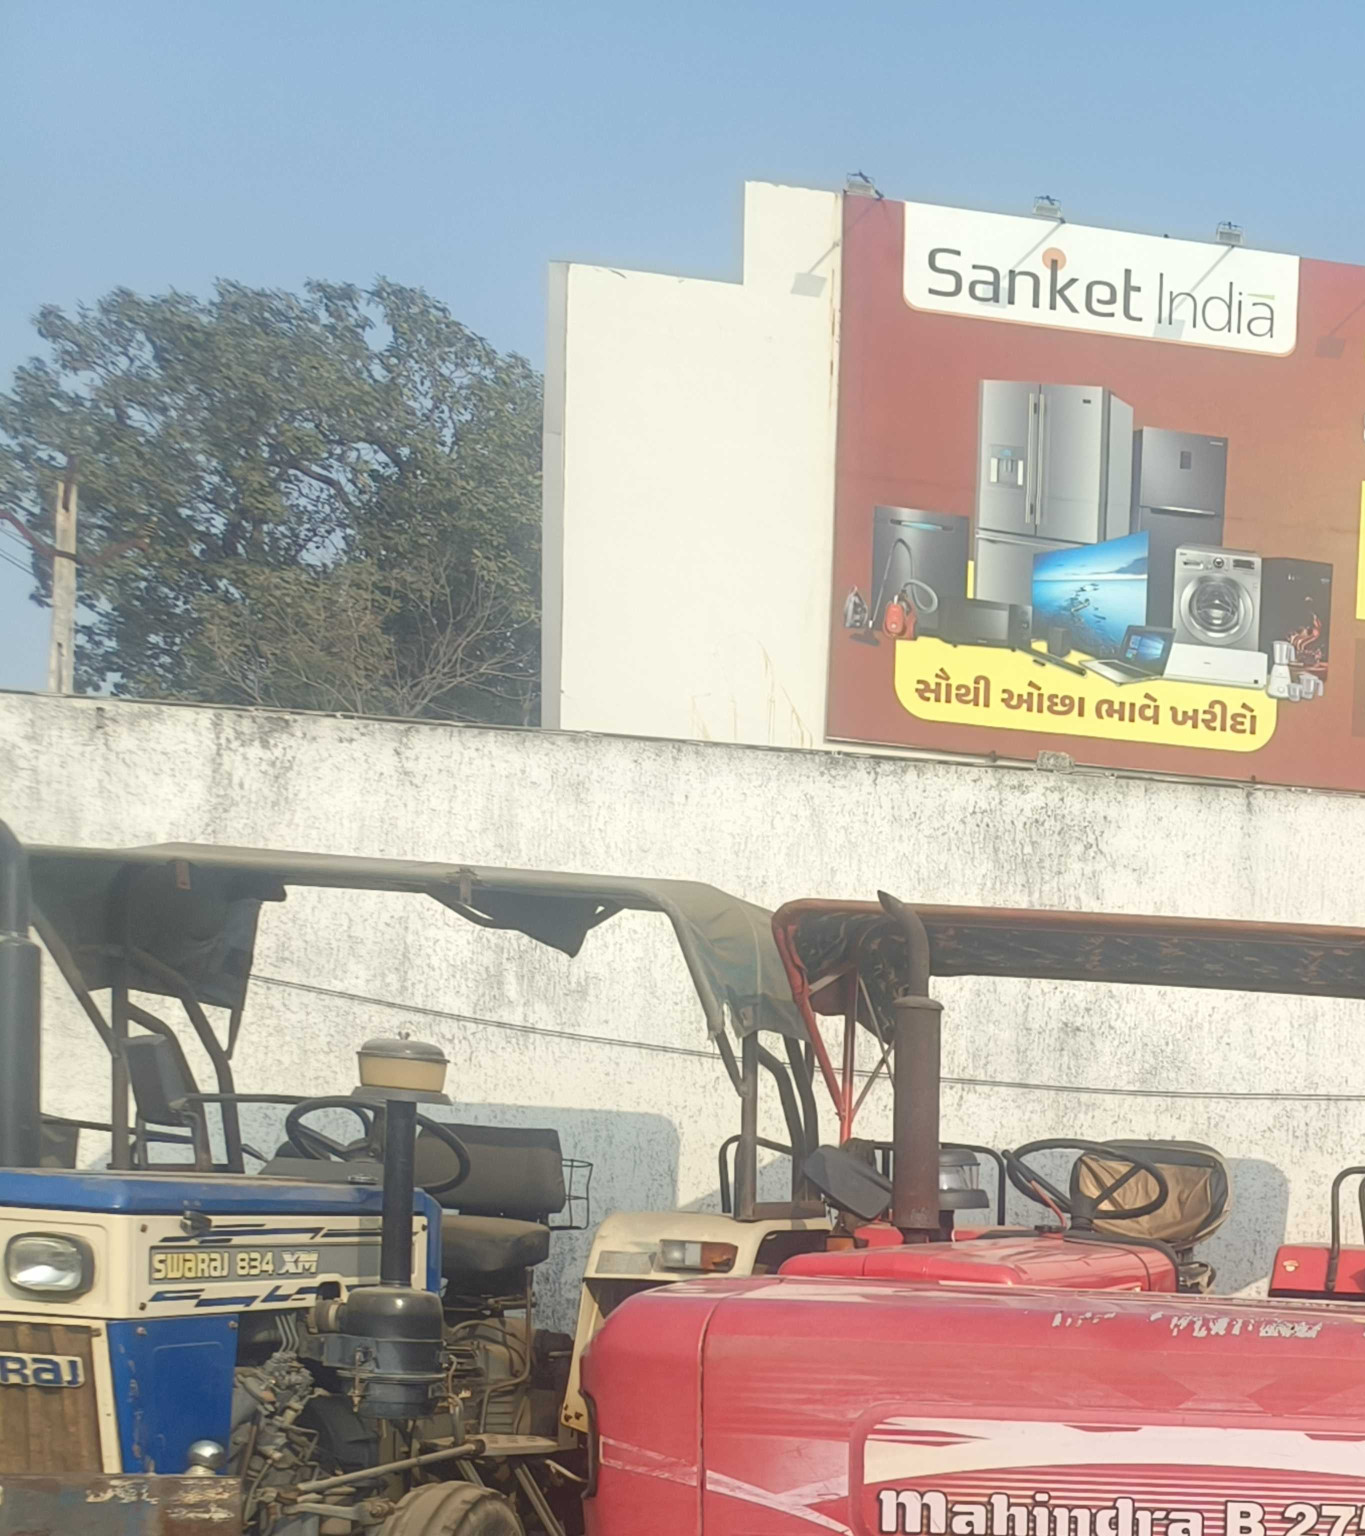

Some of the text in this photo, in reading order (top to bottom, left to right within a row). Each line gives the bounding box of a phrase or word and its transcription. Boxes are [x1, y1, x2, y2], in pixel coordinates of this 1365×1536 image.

[926, 246, 1276, 339] Sanket India
[913, 668, 1258, 736] સૌથી ઓછા ભાવે ખરીદો
[236, 1251, 274, 1276] 834
[277, 1251, 319, 1275] XM
